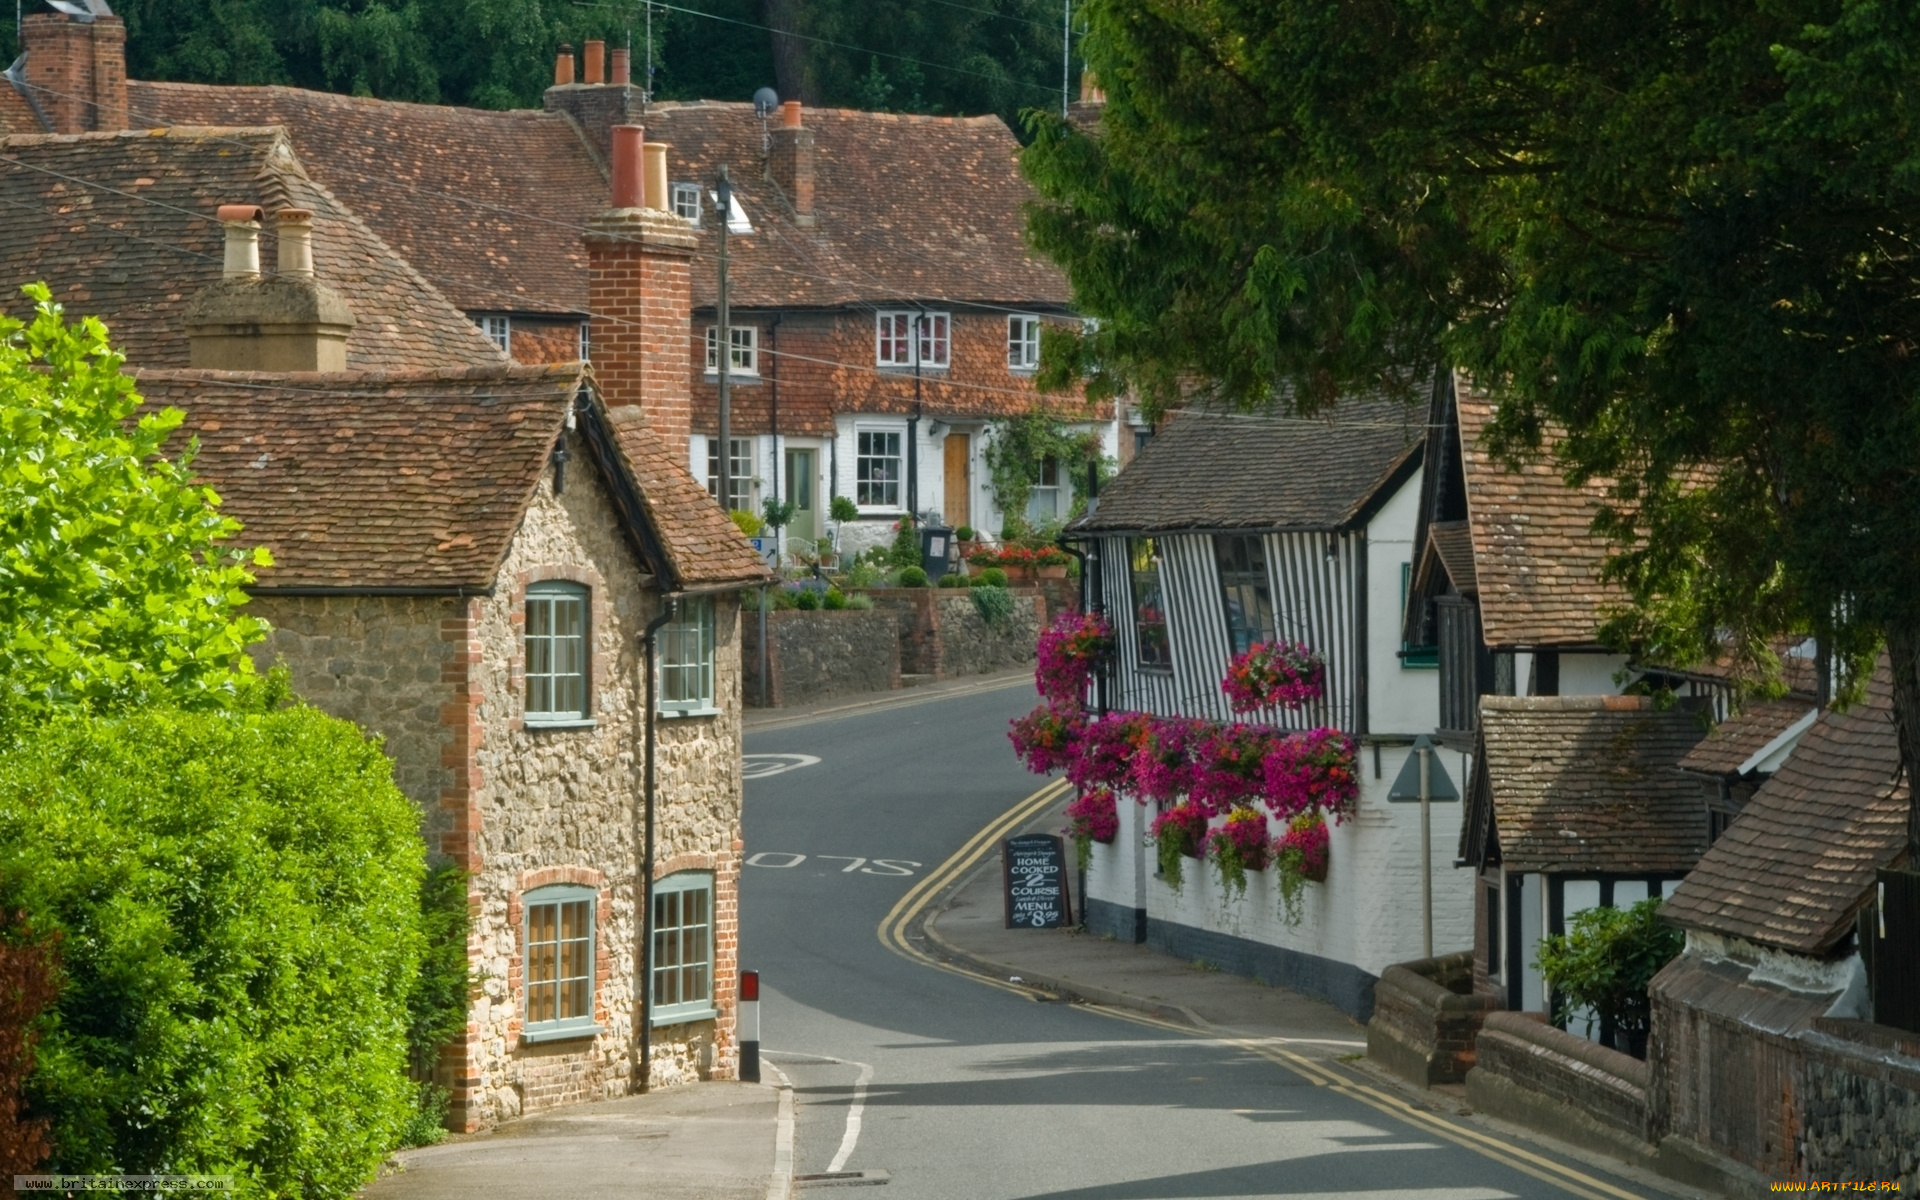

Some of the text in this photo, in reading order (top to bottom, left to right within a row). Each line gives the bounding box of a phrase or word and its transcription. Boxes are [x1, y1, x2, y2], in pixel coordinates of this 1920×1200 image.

[1017, 858, 1050, 866] HOME
[1011, 866, 1059, 874] COOKED
[1025, 873, 1045, 887] 2
[1011, 887, 1060, 896] COURSE
[1015, 902, 1053, 911] MENU
